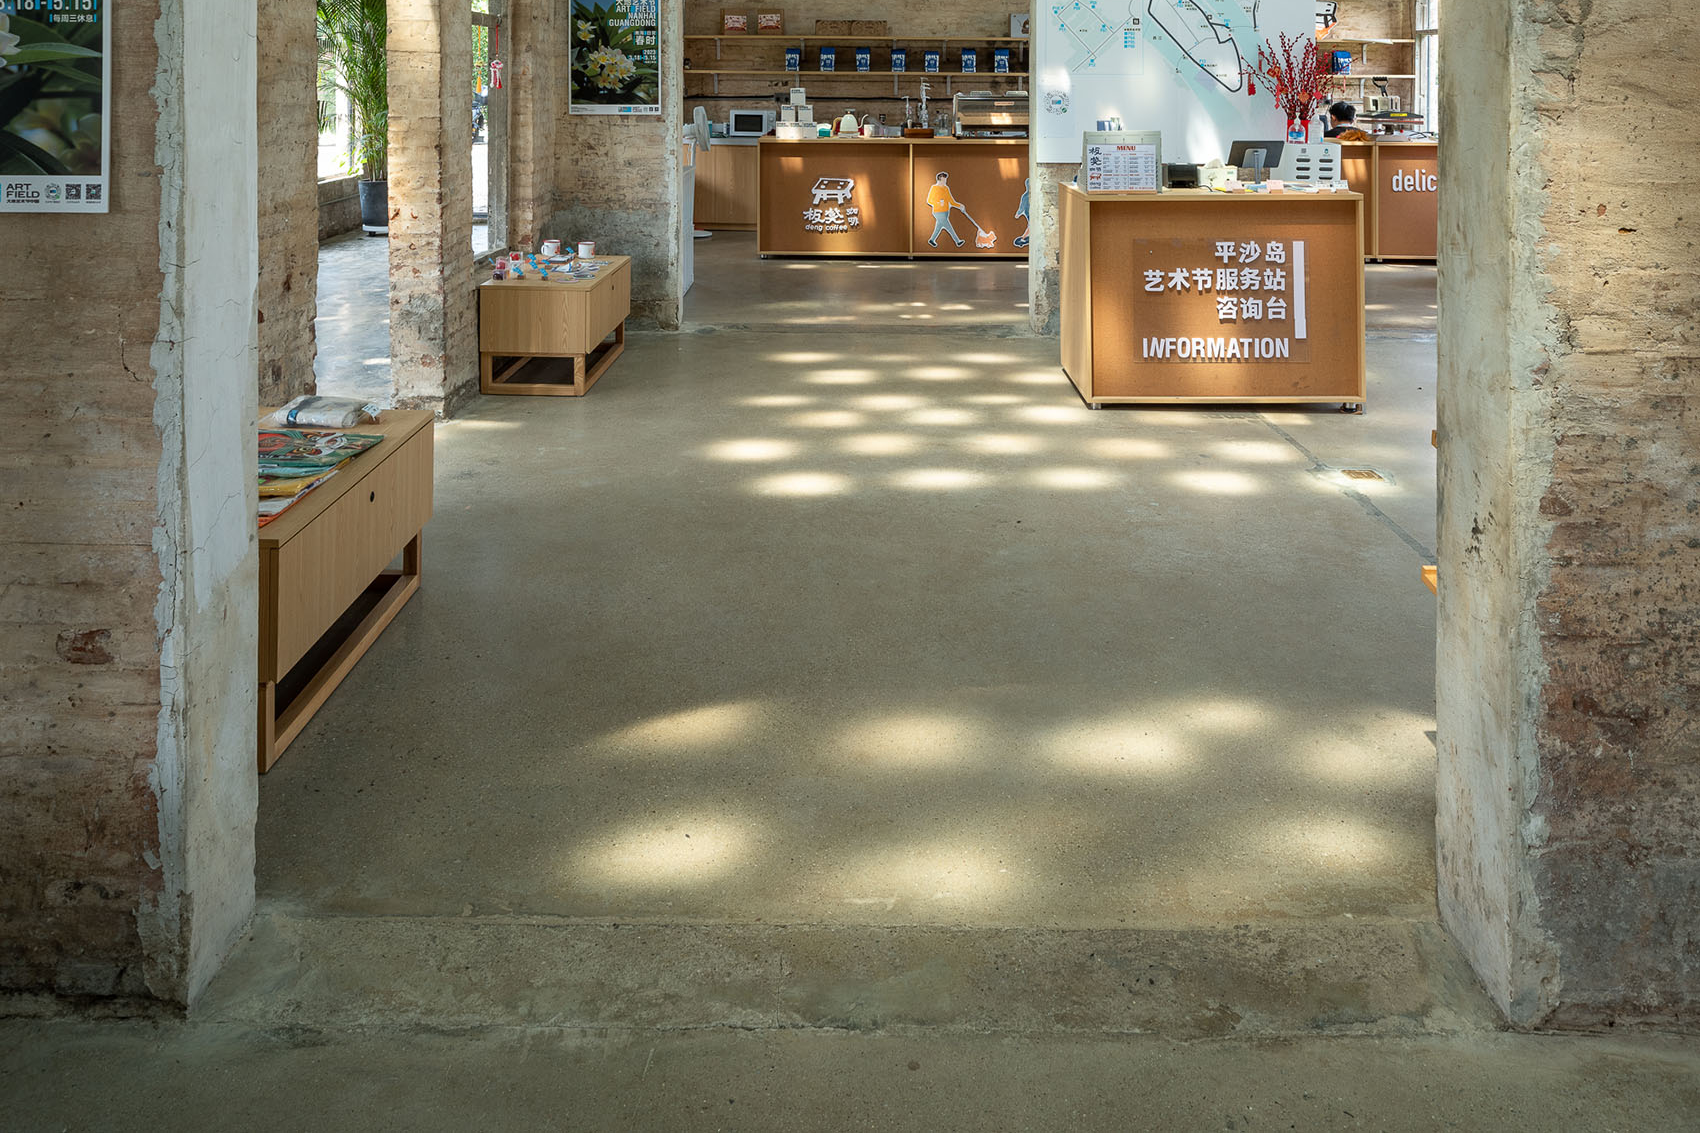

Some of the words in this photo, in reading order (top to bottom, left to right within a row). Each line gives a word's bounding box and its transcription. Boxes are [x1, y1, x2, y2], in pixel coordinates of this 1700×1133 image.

[615, 5, 631, 13] ART
[635, 5, 656, 13] FIELD
[608, 19, 656, 27] GUANGDONG
[1392, 169, 1438, 192] delic
[6, 190, 40, 198] FIELD
[805, 224, 823, 232] deng
[1214, 240, 1287, 264] 平沙岛
[1143, 267, 1287, 292] 艺术节服务站
[1215, 296, 1288, 321] 咨询台
[1142, 337, 1290, 359] INFORMATION
